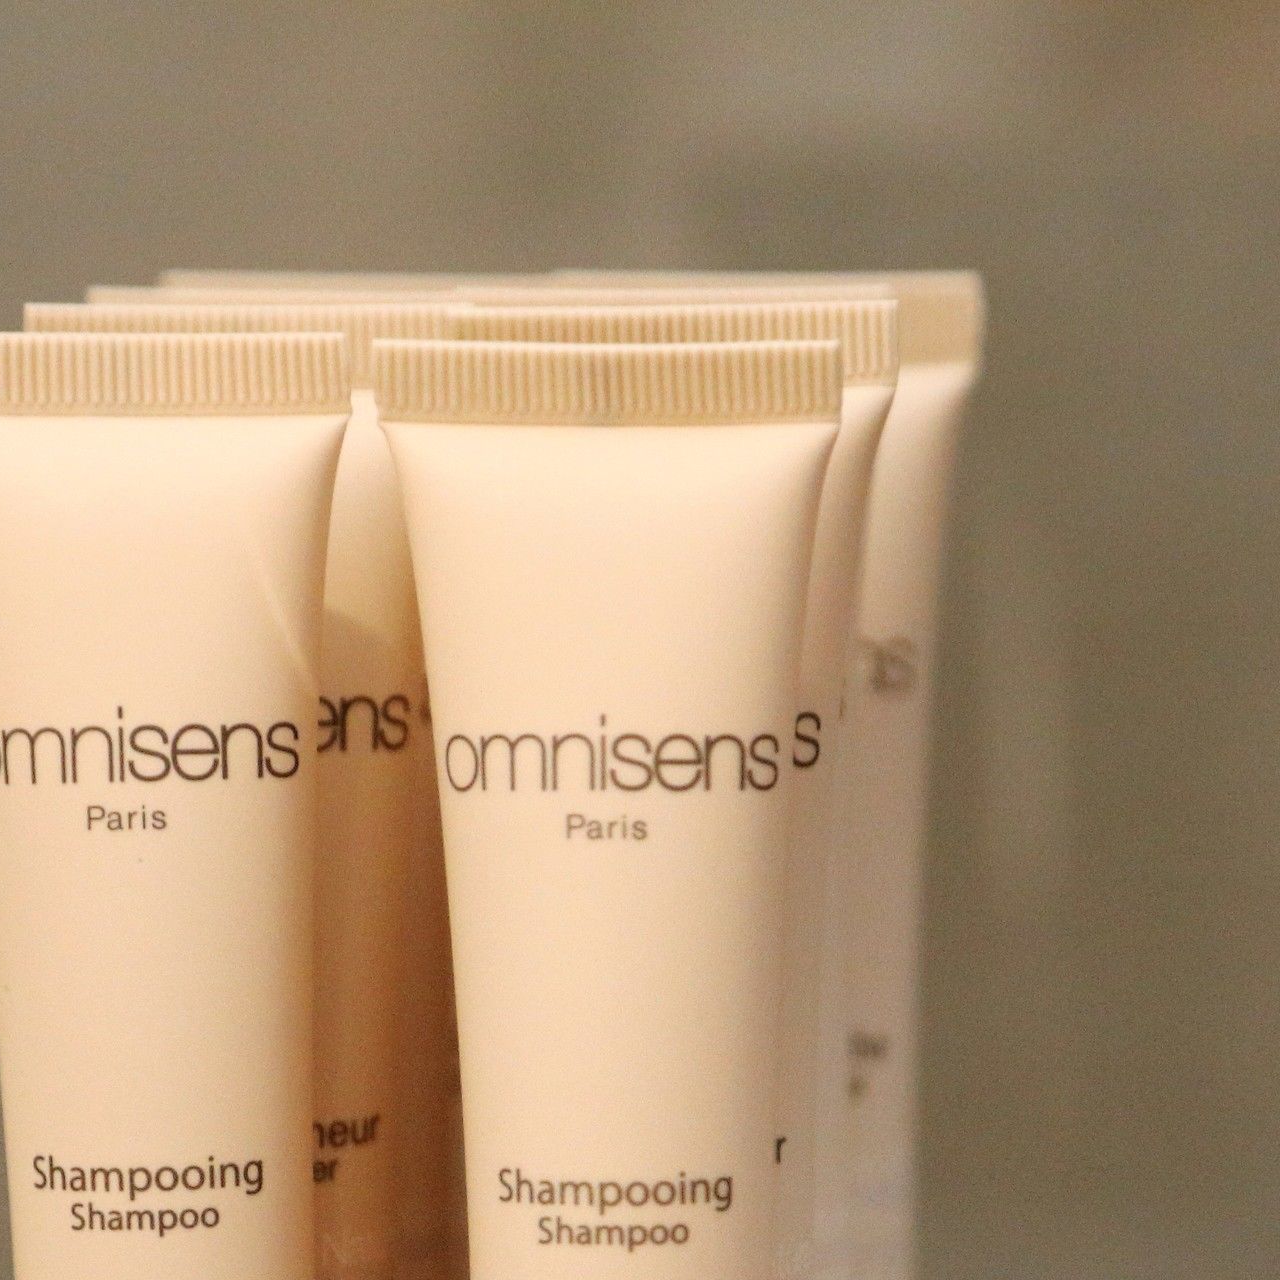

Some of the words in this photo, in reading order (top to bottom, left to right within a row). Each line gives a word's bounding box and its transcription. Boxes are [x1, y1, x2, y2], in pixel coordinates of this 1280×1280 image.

[444, 715, 780, 794] omnisens
[85, 803, 169, 832] Paris
[564, 812, 649, 842] Paris
[32, 1155, 265, 1201] Shampooing
[497, 1167, 735, 1214] Shampooing
[70, 1202, 221, 1238] Shampoo
[537, 1216, 691, 1253] Shampoo
